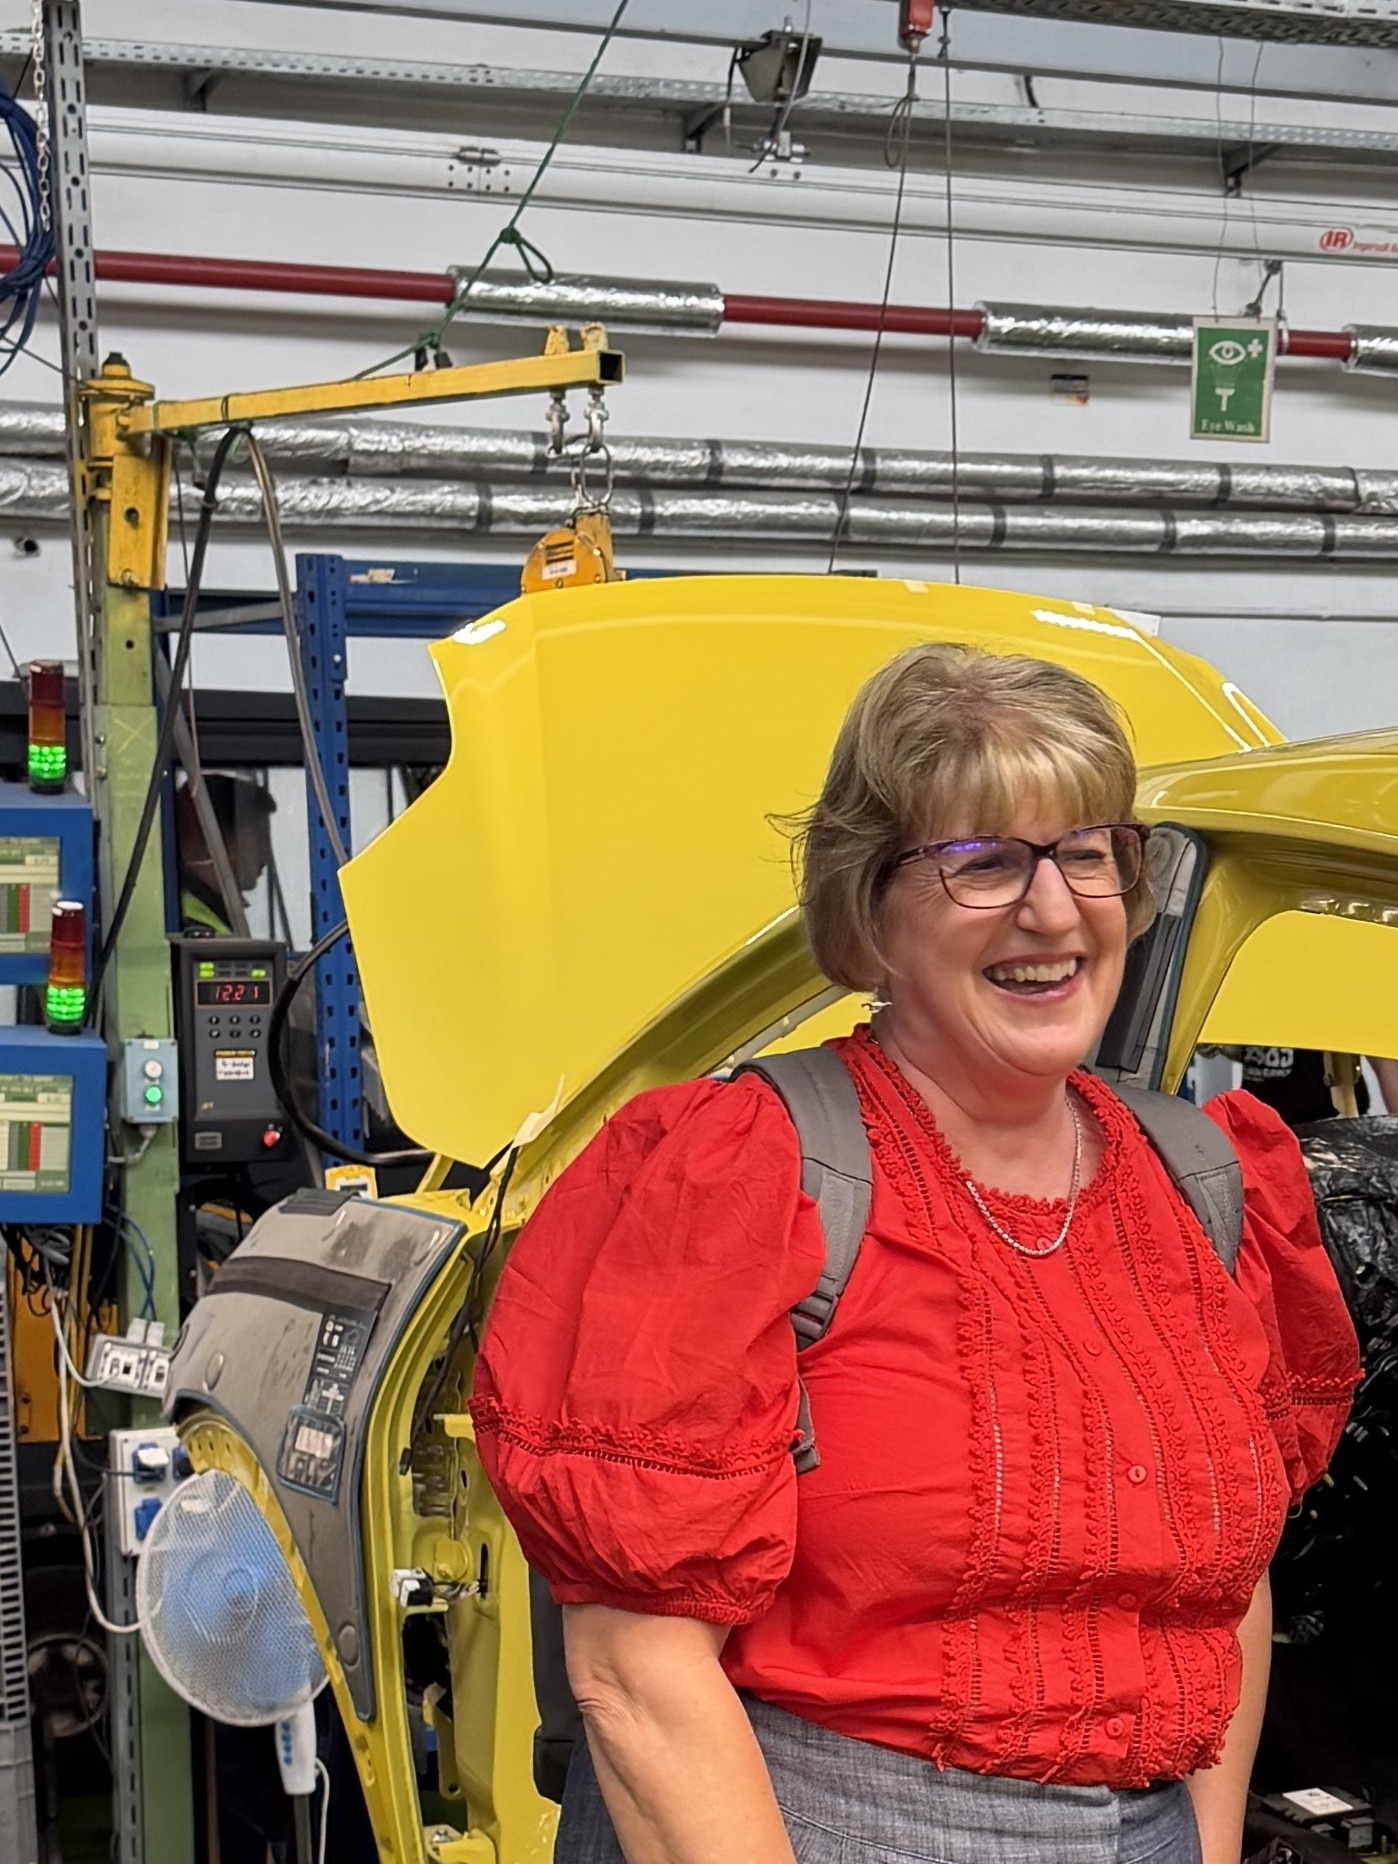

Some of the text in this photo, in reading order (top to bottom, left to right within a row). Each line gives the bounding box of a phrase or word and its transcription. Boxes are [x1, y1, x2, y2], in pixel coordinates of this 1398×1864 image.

[1326, 231, 1348, 248] IR
[1201, 419, 1255, 434] Eye Wash
